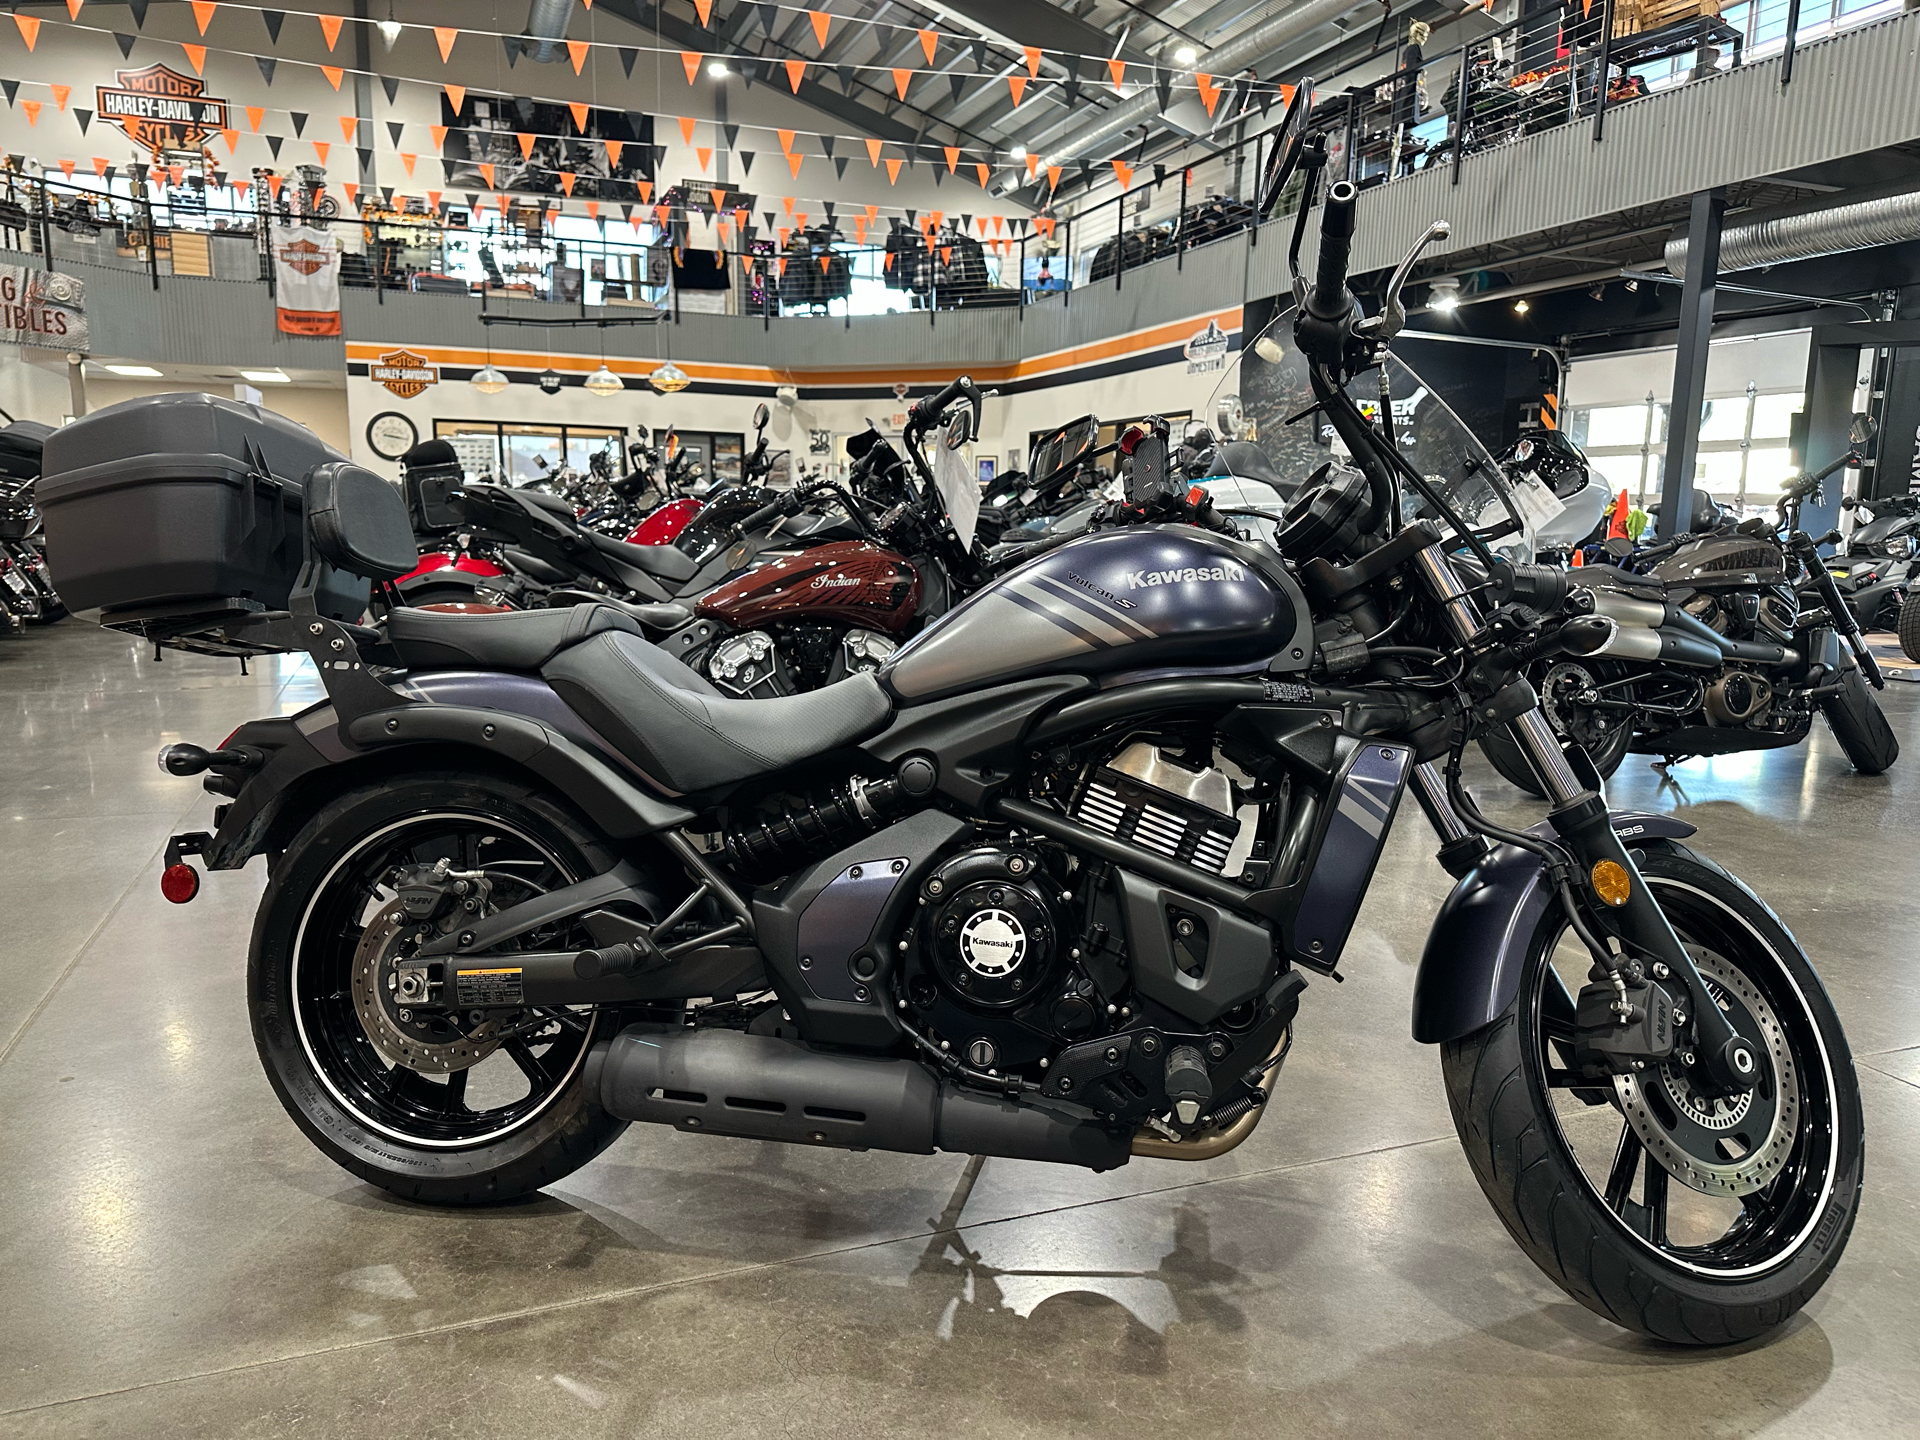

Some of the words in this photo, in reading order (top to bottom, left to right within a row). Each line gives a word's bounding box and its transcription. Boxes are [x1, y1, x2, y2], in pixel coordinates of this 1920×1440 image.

[131, 72, 192, 96] MOTOR
[389, 356, 420, 368] MOTOR
[374, 368, 434, 381] HARLEY-DAVIDSON
[810, 574, 861, 589] Indian
[1127, 566, 1245, 590] Kawasaki
[1114, 598, 1138, 610] S
[1614, 825, 1644, 837] ABS
[972, 937, 1013, 948] Kawasaki
[1812, 1201, 1847, 1255] PIRELLI
